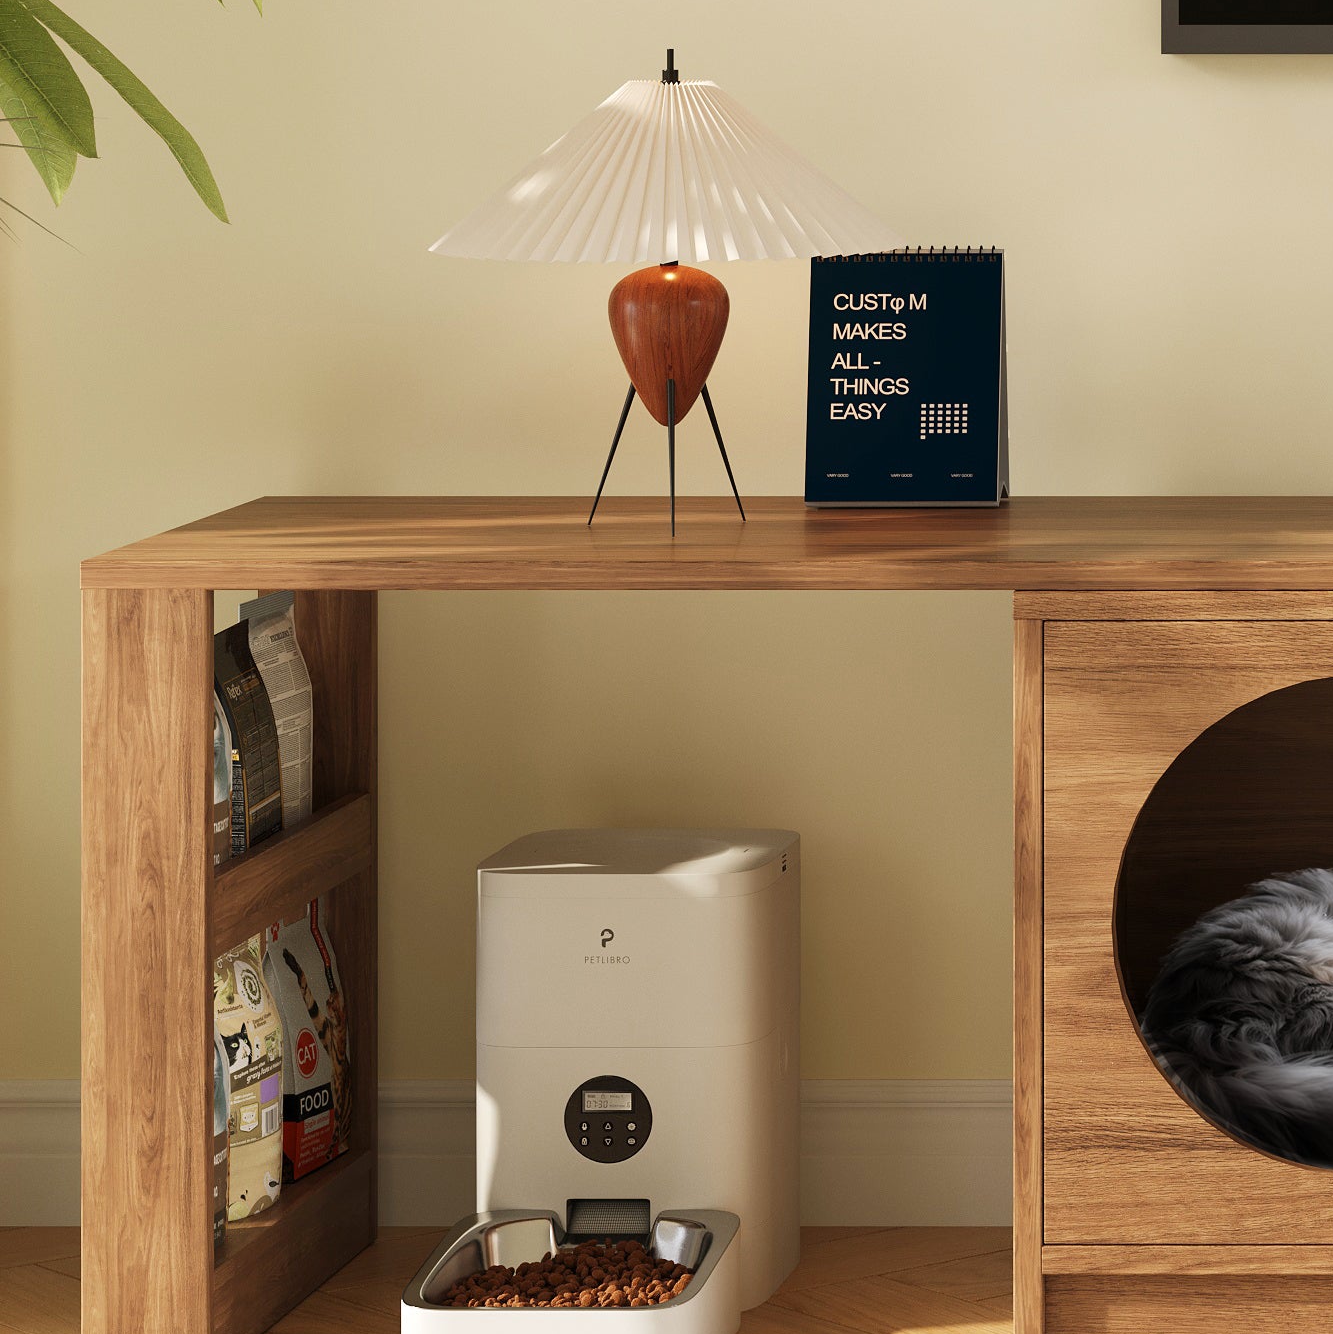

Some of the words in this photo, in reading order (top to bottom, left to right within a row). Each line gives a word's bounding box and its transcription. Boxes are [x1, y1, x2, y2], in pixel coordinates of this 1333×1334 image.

[832, 323, 907, 340] MAKES
[831, 353, 870, 370] ALL
[829, 378, 910, 396] THINGS
[829, 403, 887, 420] EASY
[584, 955, 631, 965] PETLIBRO
[297, 1042, 316, 1065] CAT
[300, 1089, 329, 1115] FOOD
